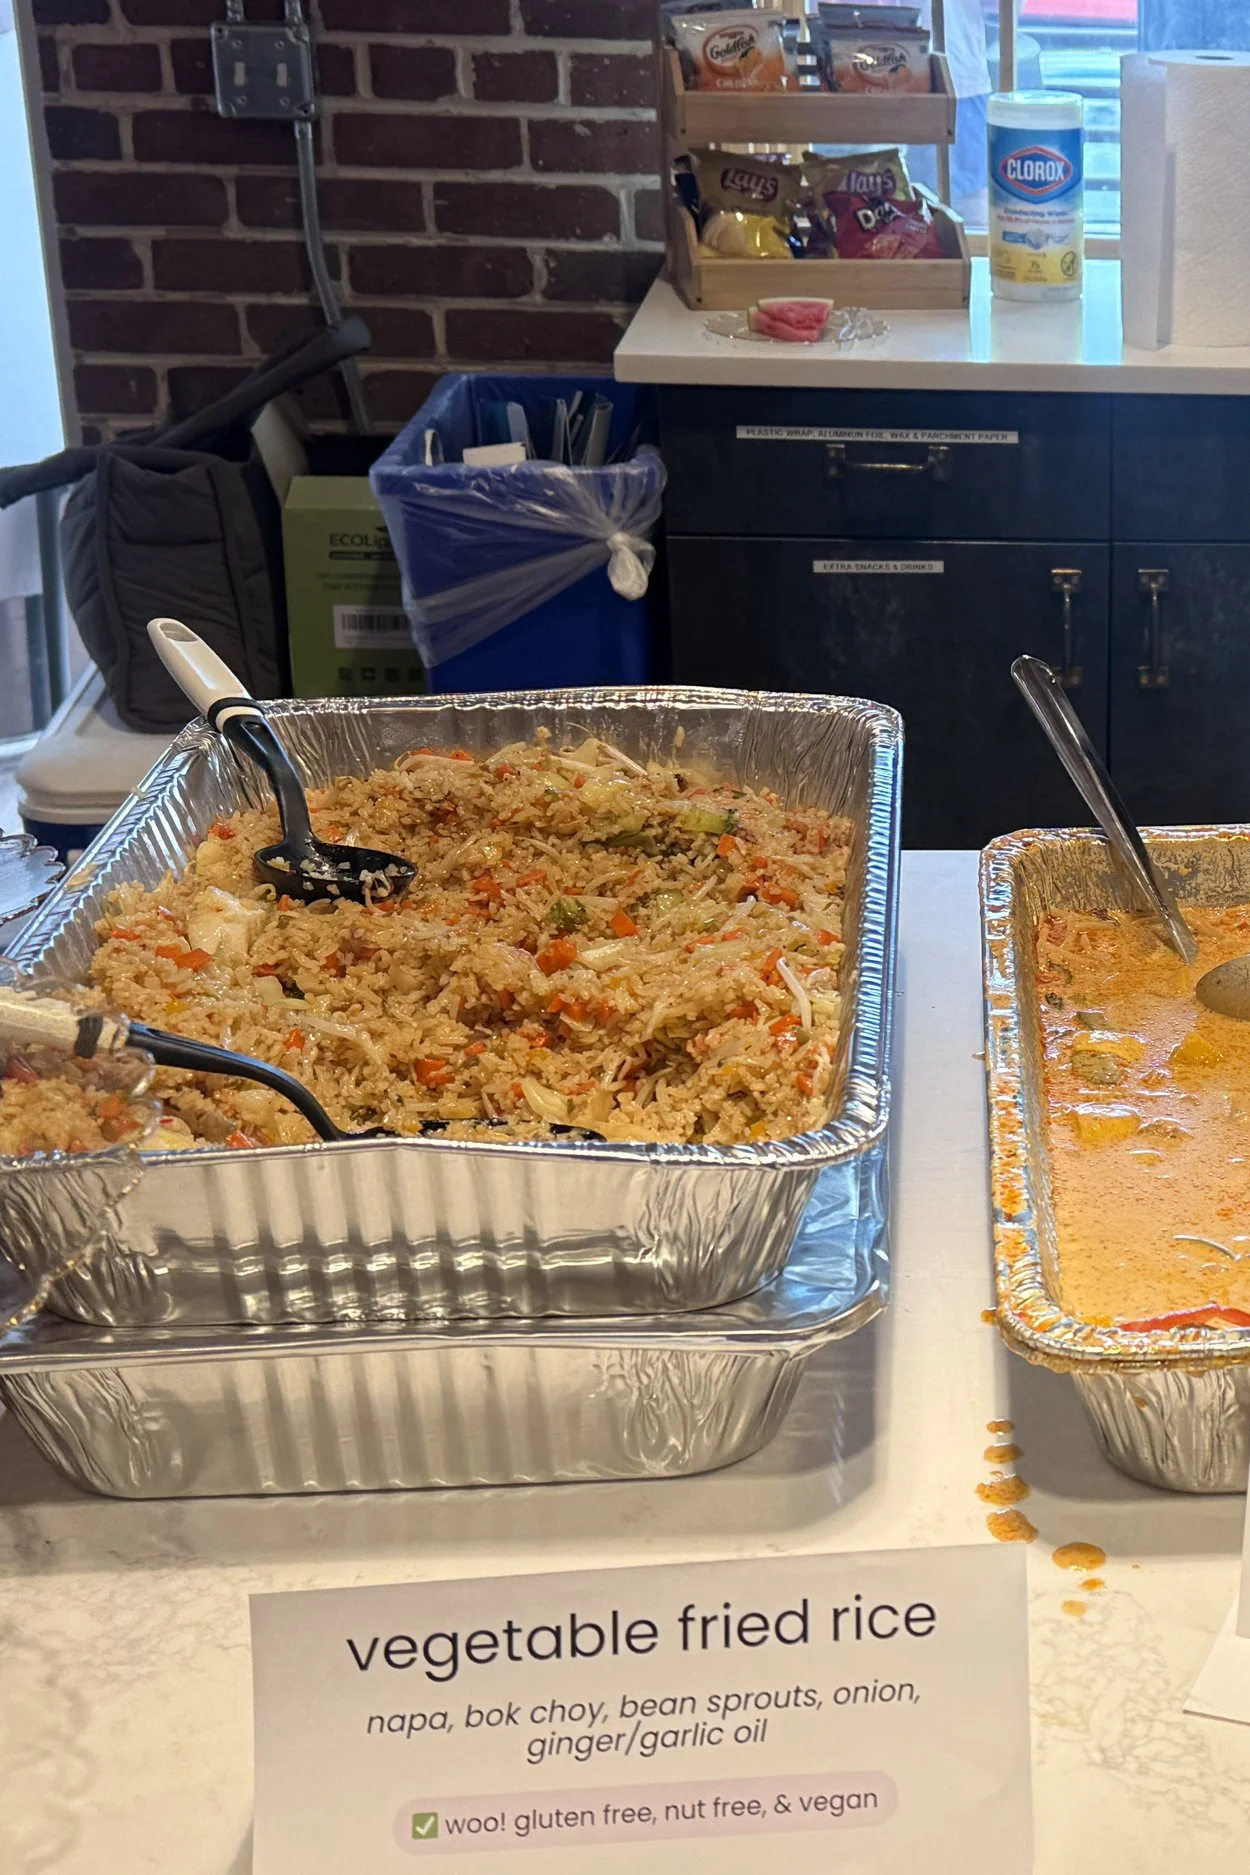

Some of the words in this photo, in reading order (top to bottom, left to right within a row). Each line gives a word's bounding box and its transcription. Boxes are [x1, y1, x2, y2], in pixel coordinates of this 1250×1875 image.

[710, 33, 754, 60] Goldfish
[1006, 159, 1065, 182] CLOROX
[745, 429, 783, 438] PLASTIC
[921, 433, 976, 441] PARCHMENT
[823, 563, 853, 571] EXTRA
[855, 563, 890, 571] SNACKS
[900, 563, 933, 571] DRINKS
[346, 1609, 659, 1684] vegetable
[677, 1597, 809, 1652] fried
[832, 1593, 937, 1643] rice
[366, 1711, 454, 1740] napa,
[464, 1701, 522, 1728] bok
[529, 1698, 609, 1730] choy,
[619, 1694, 697, 1719] bean
[706, 1685, 823, 1721] sprouts,
[832, 1678, 920, 1706] onion,
[526, 1719, 725, 1765] ginger/garlic
[733, 1718, 768, 1744] oil
[444, 1811, 506, 1835] woo!
[514, 1807, 595, 1838] gluten
[602, 1803, 658, 1826] free,
[665, 1799, 706, 1821] nut
[712, 1796, 767, 1819] free,
[773, 1793, 792, 1815] &
[799, 1792, 878, 1818] vegan
